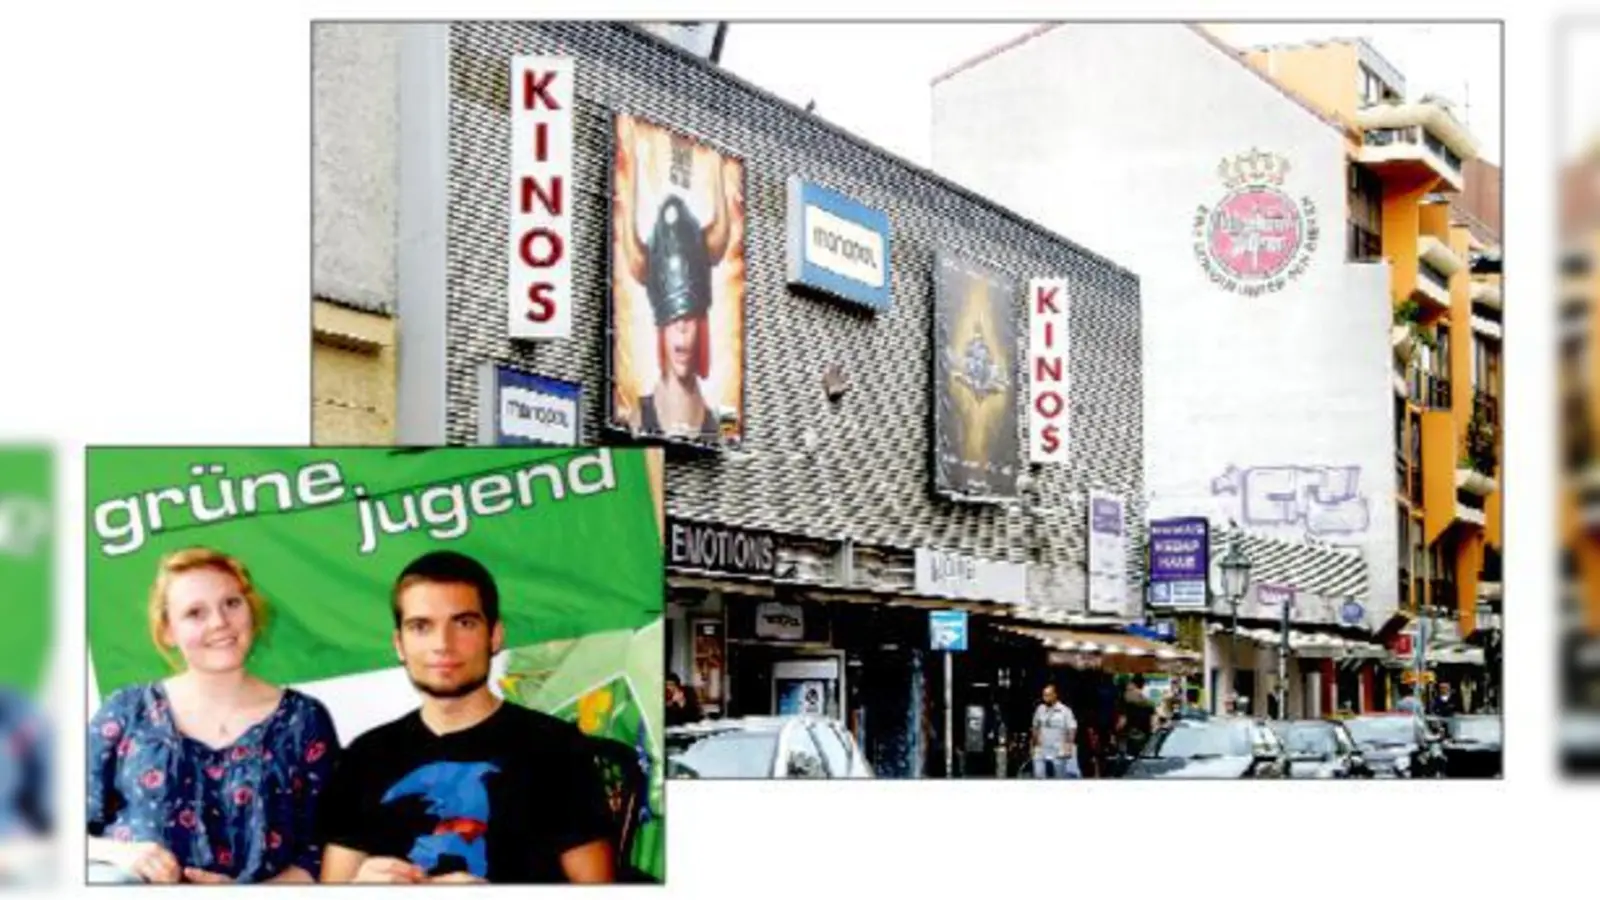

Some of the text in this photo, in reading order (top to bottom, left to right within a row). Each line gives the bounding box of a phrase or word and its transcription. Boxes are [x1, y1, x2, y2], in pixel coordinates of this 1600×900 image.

[519, 68, 564, 324] KINOS
[1034, 286, 1065, 455] KINOS
[93, 460, 347, 556] grüne
[354, 447, 618, 553] jugend
[671, 523, 775, 571] EMOTIONS
